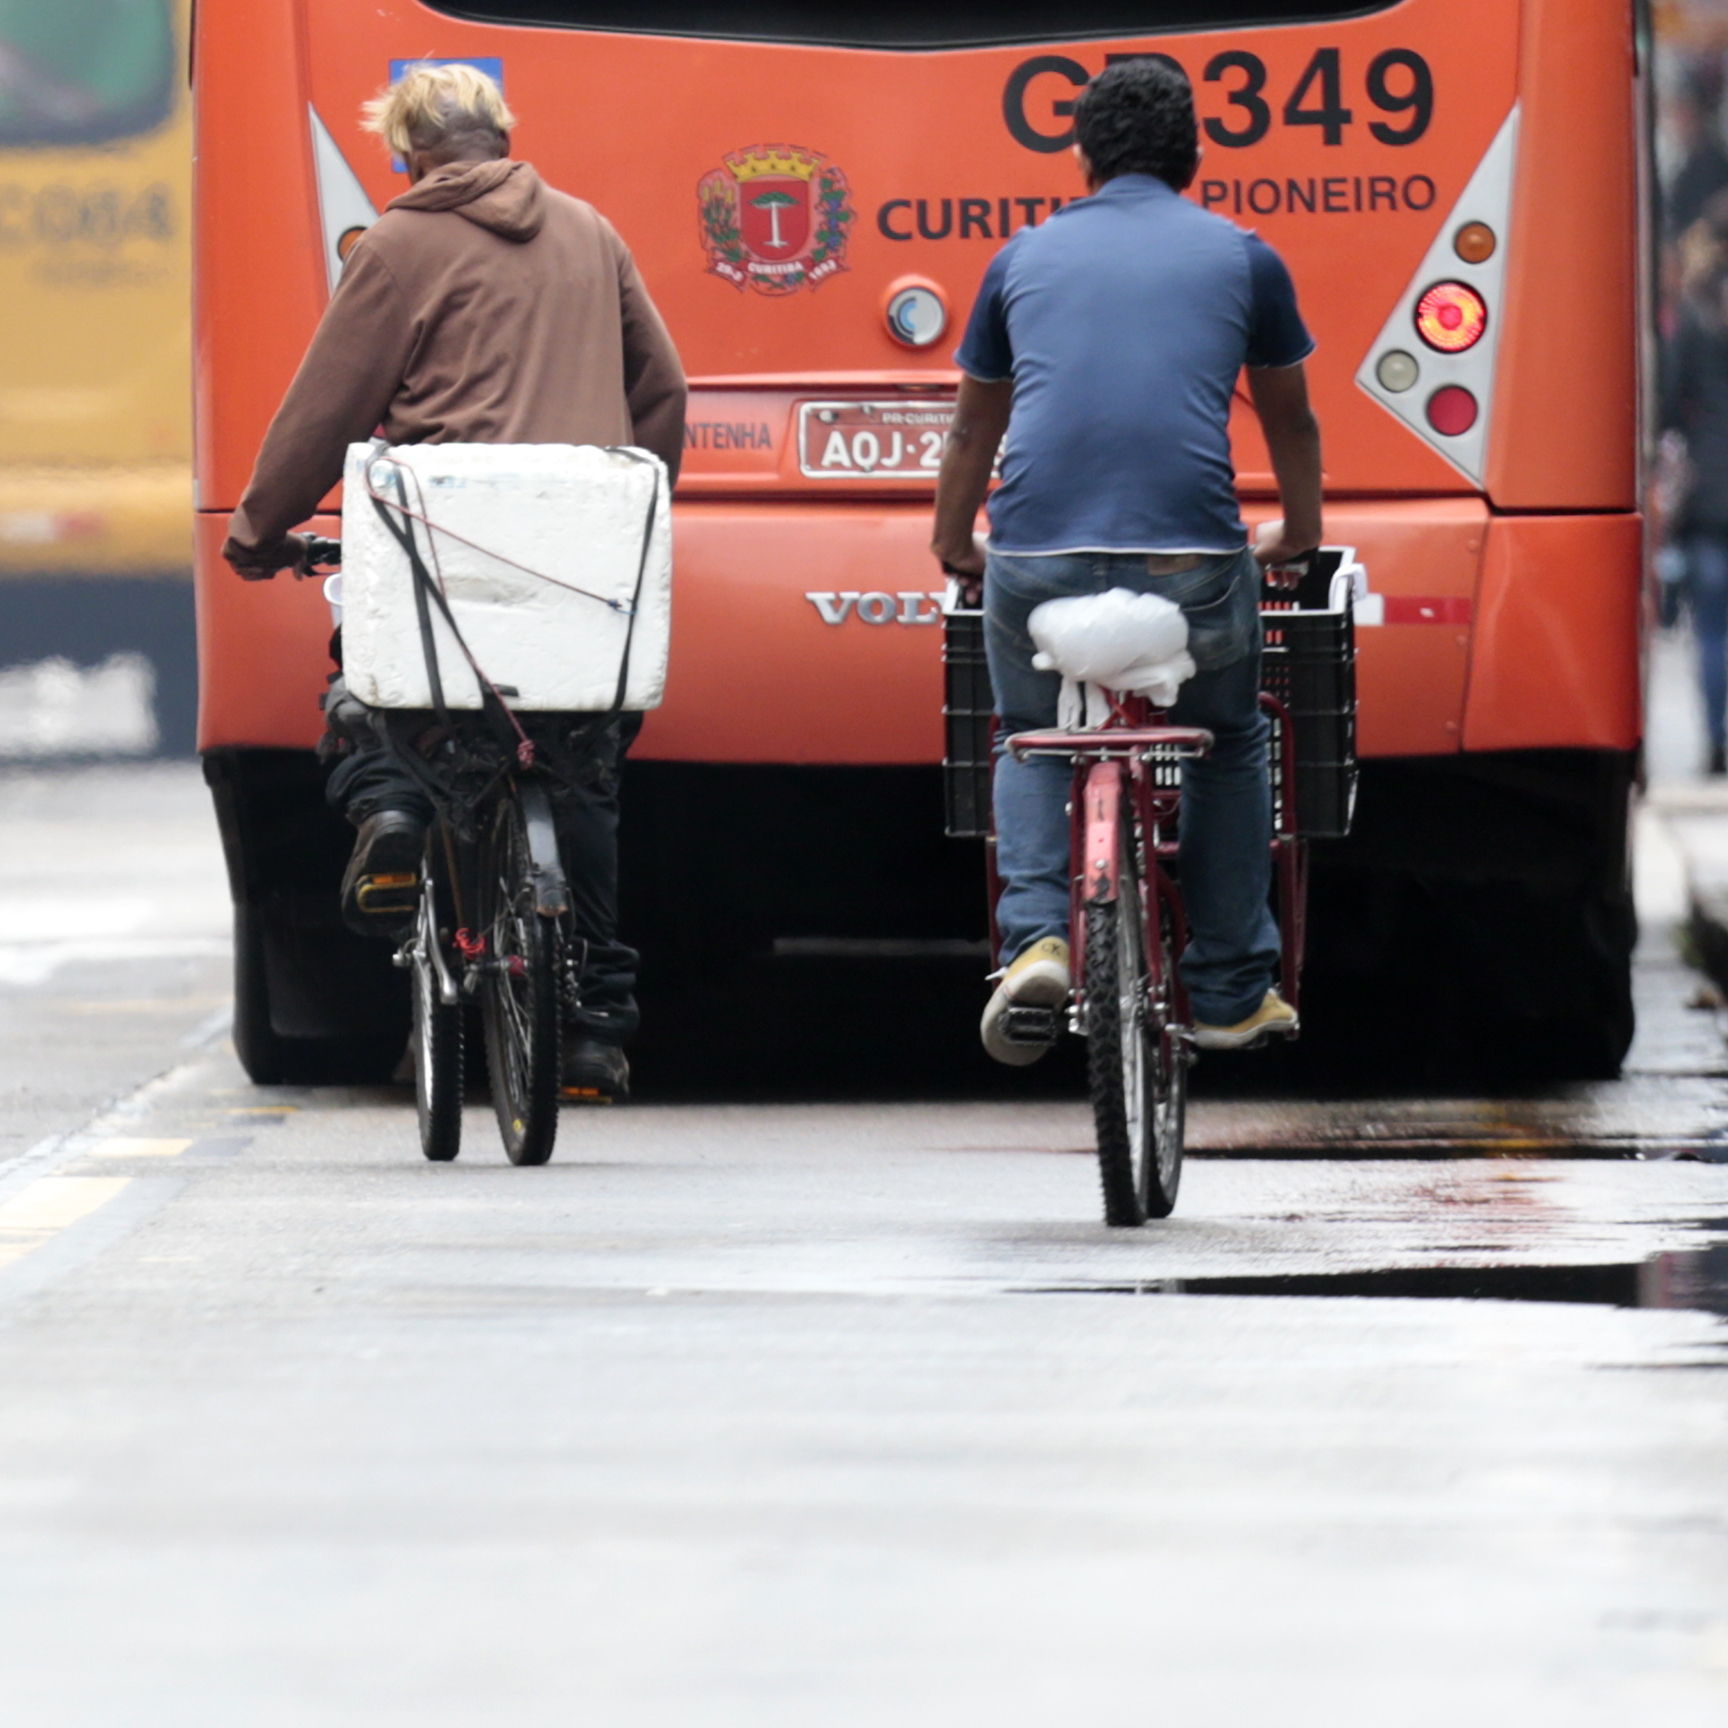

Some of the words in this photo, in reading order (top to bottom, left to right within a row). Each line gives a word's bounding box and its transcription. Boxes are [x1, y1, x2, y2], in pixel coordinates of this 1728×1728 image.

[1001, 46, 1435, 154] G349
[1201, 174, 1437, 215] PIONEIRO
[684, 422, 773, 450] NTENHA
